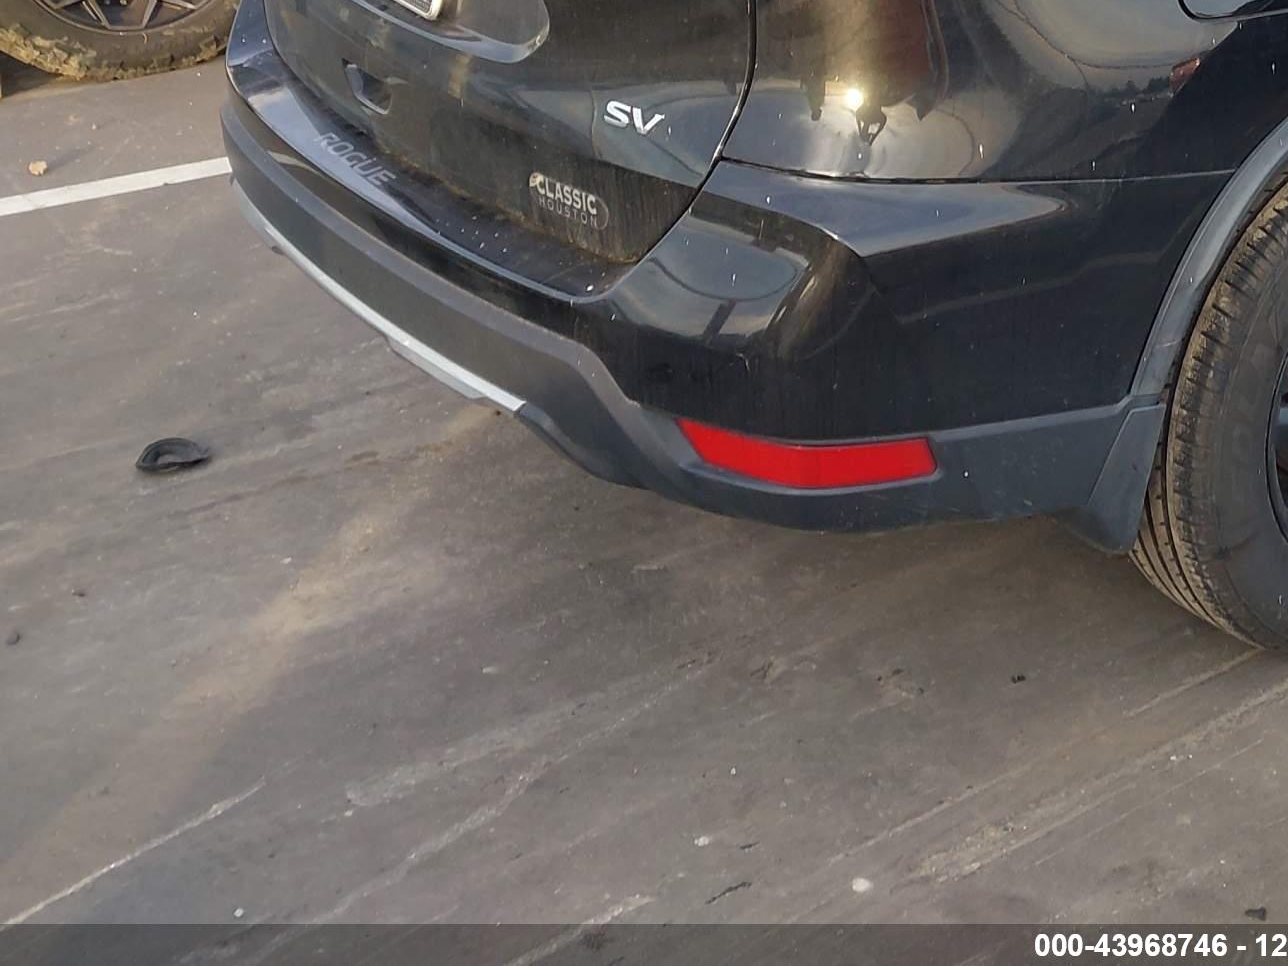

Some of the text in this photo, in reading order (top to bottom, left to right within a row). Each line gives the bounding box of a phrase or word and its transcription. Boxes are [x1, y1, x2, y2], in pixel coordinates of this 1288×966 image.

[603, 100, 665, 135] SV
[315, 132, 396, 185] ROGUE
[537, 177, 597, 215] CLASSIC
[539, 196, 597, 227] HOUSTON
